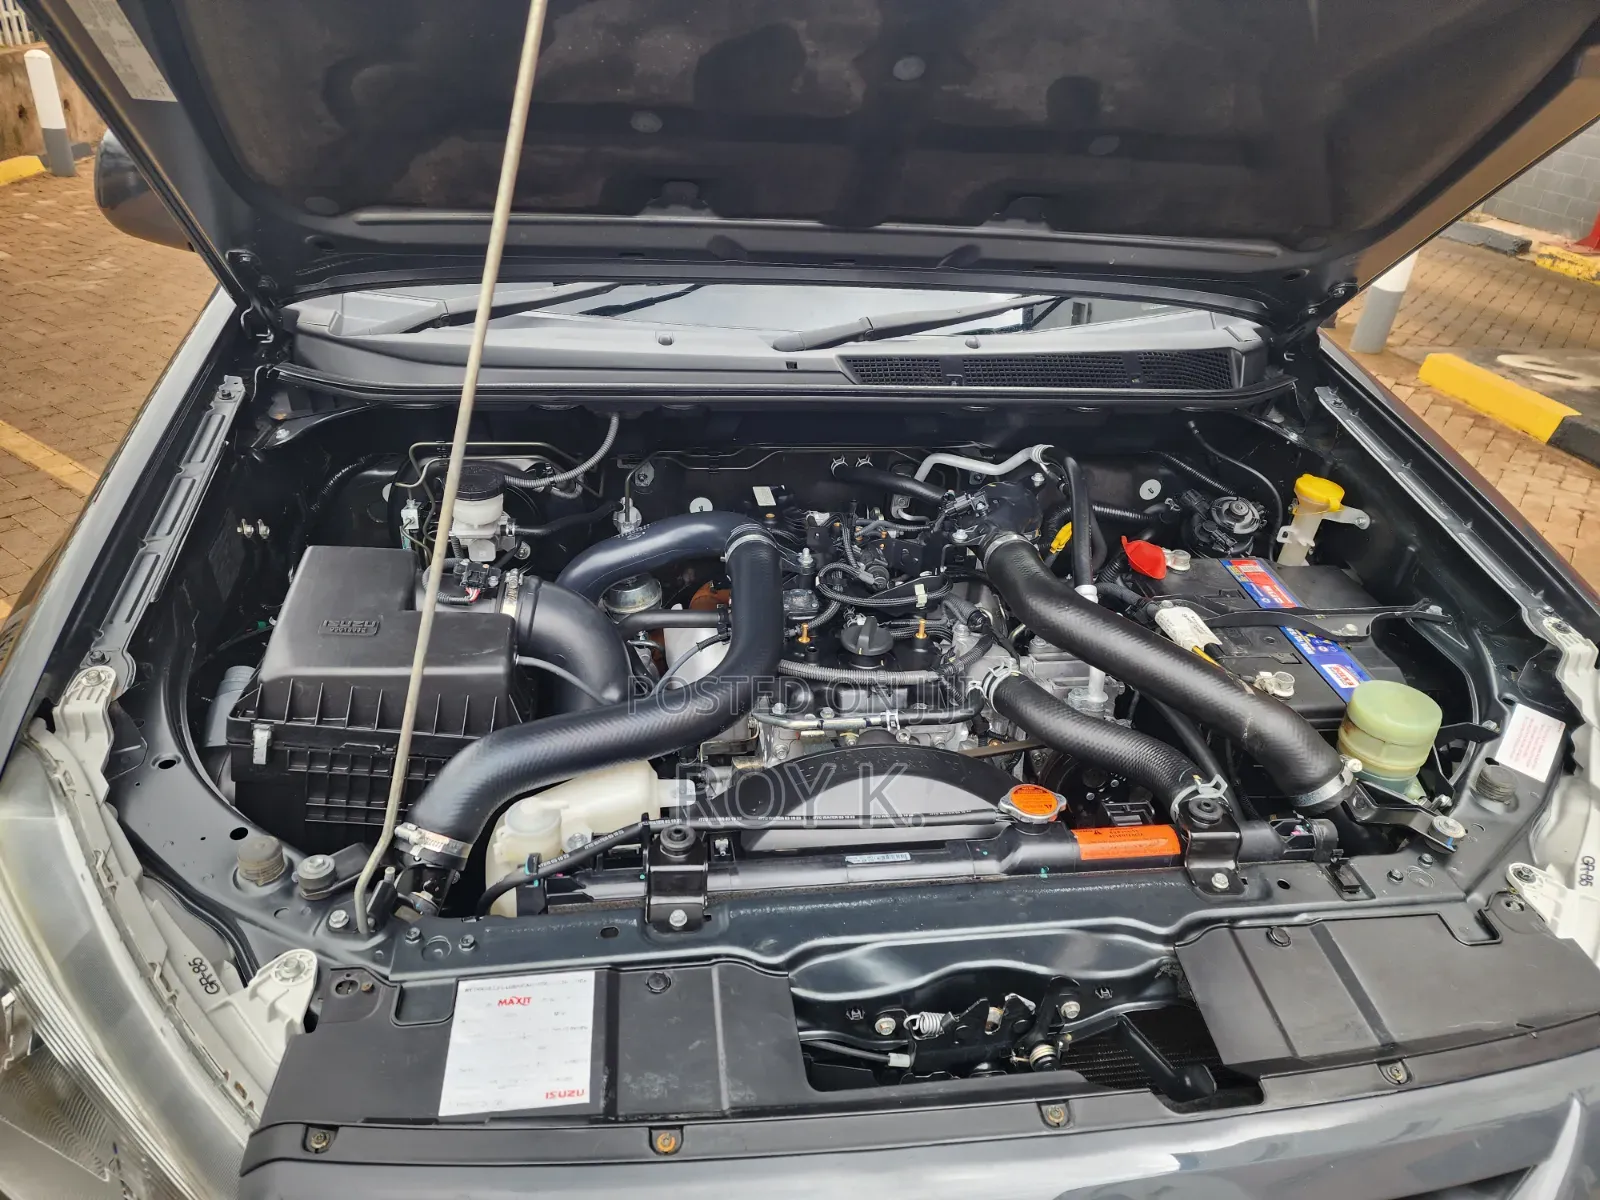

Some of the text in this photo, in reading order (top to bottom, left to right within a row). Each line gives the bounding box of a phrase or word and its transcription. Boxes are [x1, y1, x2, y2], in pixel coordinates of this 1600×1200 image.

[188, 957, 221, 995] GR-85
[497, 996, 532, 1006] MAXIT
[545, 1089, 585, 1100] ISUZU
